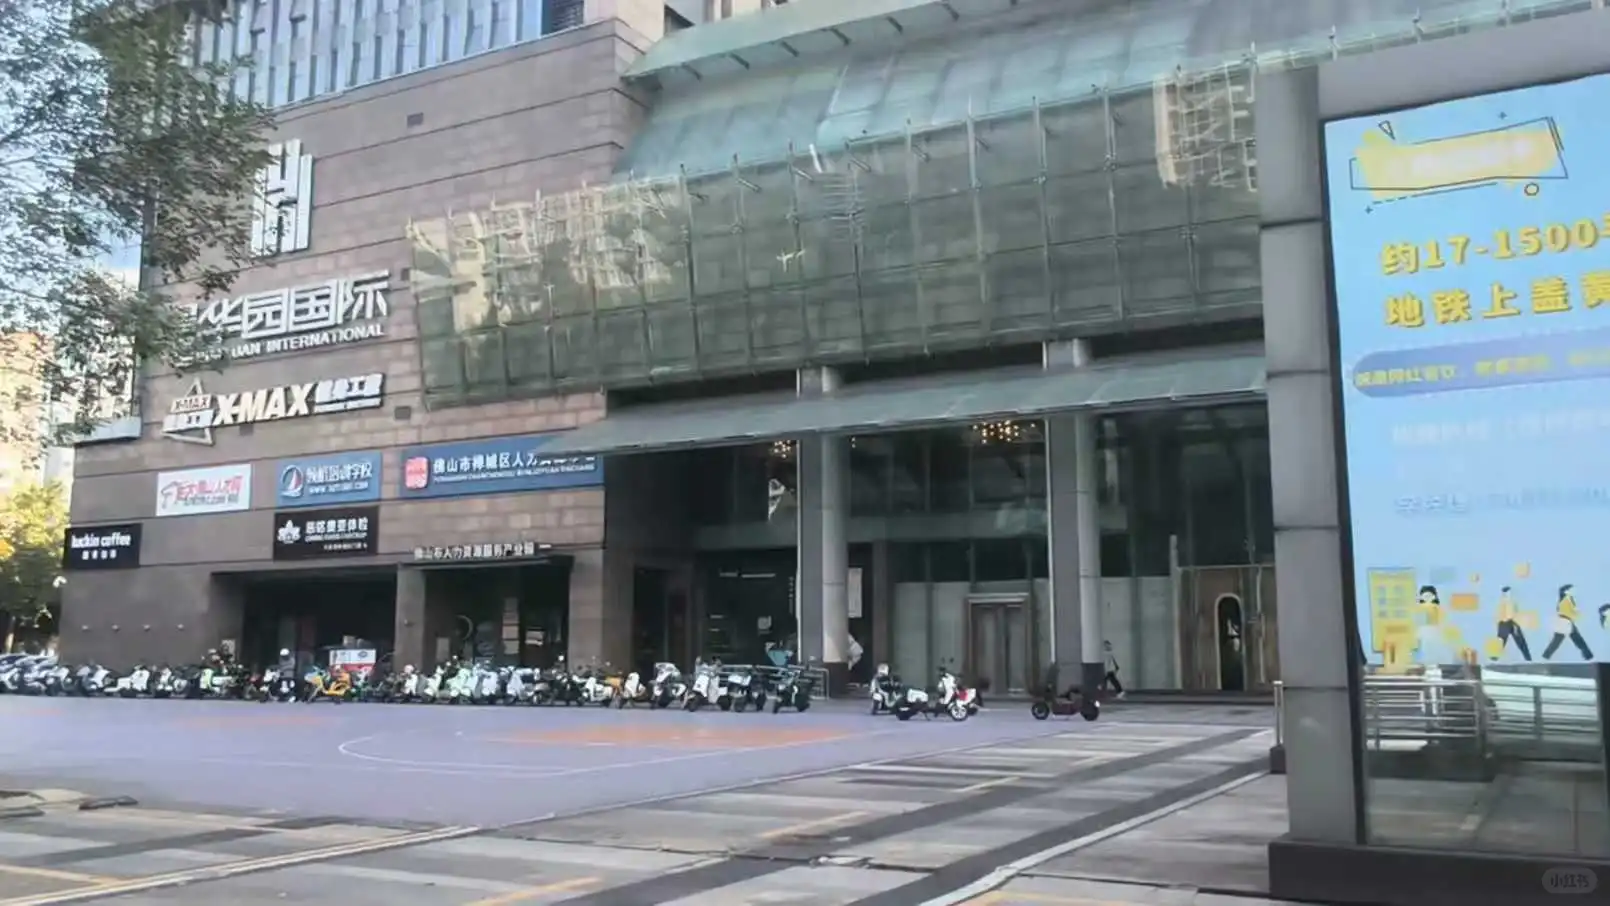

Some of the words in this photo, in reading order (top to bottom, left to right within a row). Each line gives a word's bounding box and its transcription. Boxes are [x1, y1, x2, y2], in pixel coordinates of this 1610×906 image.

[1383, 213, 1610, 275] 约17-1500
[178, 269, 389, 342] 华园国际
[267, 323, 385, 352] INTERNATIONAL
[173, 395, 209, 411] X-MAX
[212, 383, 314, 425] X-MAX
[433, 451, 595, 474] 佛山市禅城区人力
[71, 532, 100, 548] luckin
[101, 531, 131, 547] coffee
